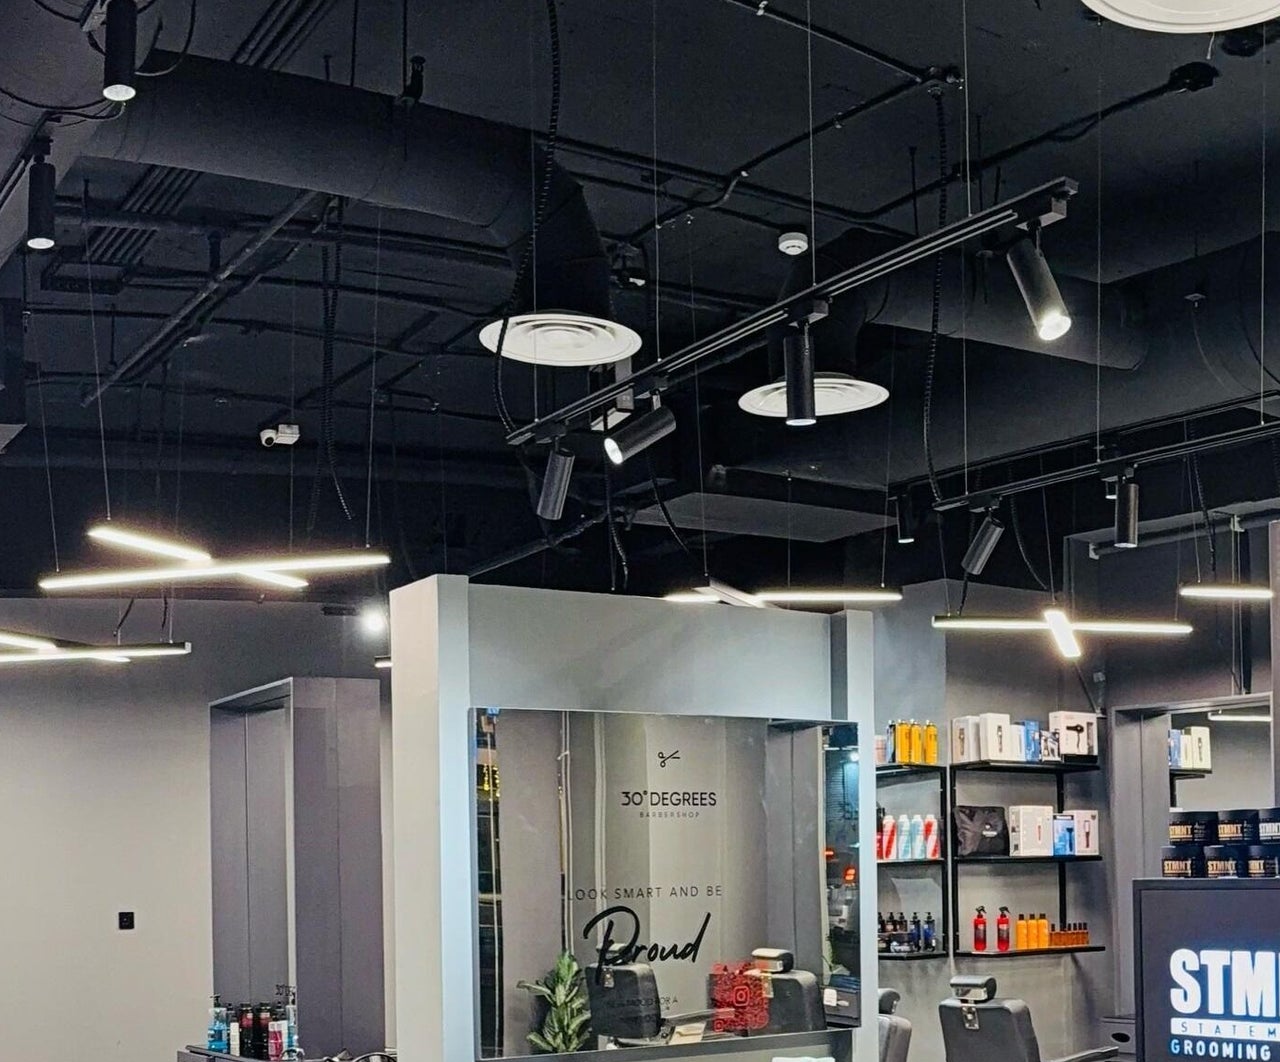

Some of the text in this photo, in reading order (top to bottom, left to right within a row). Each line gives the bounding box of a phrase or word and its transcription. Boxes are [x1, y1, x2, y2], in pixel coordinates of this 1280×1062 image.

[639, 811, 700, 819] BARBERSHOP
[614, 887, 663, 899] SMART
[669, 886, 699, 898] AND
[706, 885, 723, 897] BE
[582, 905, 712, 986] Proud
[1170, 1038, 1271, 1062] GROOMING
